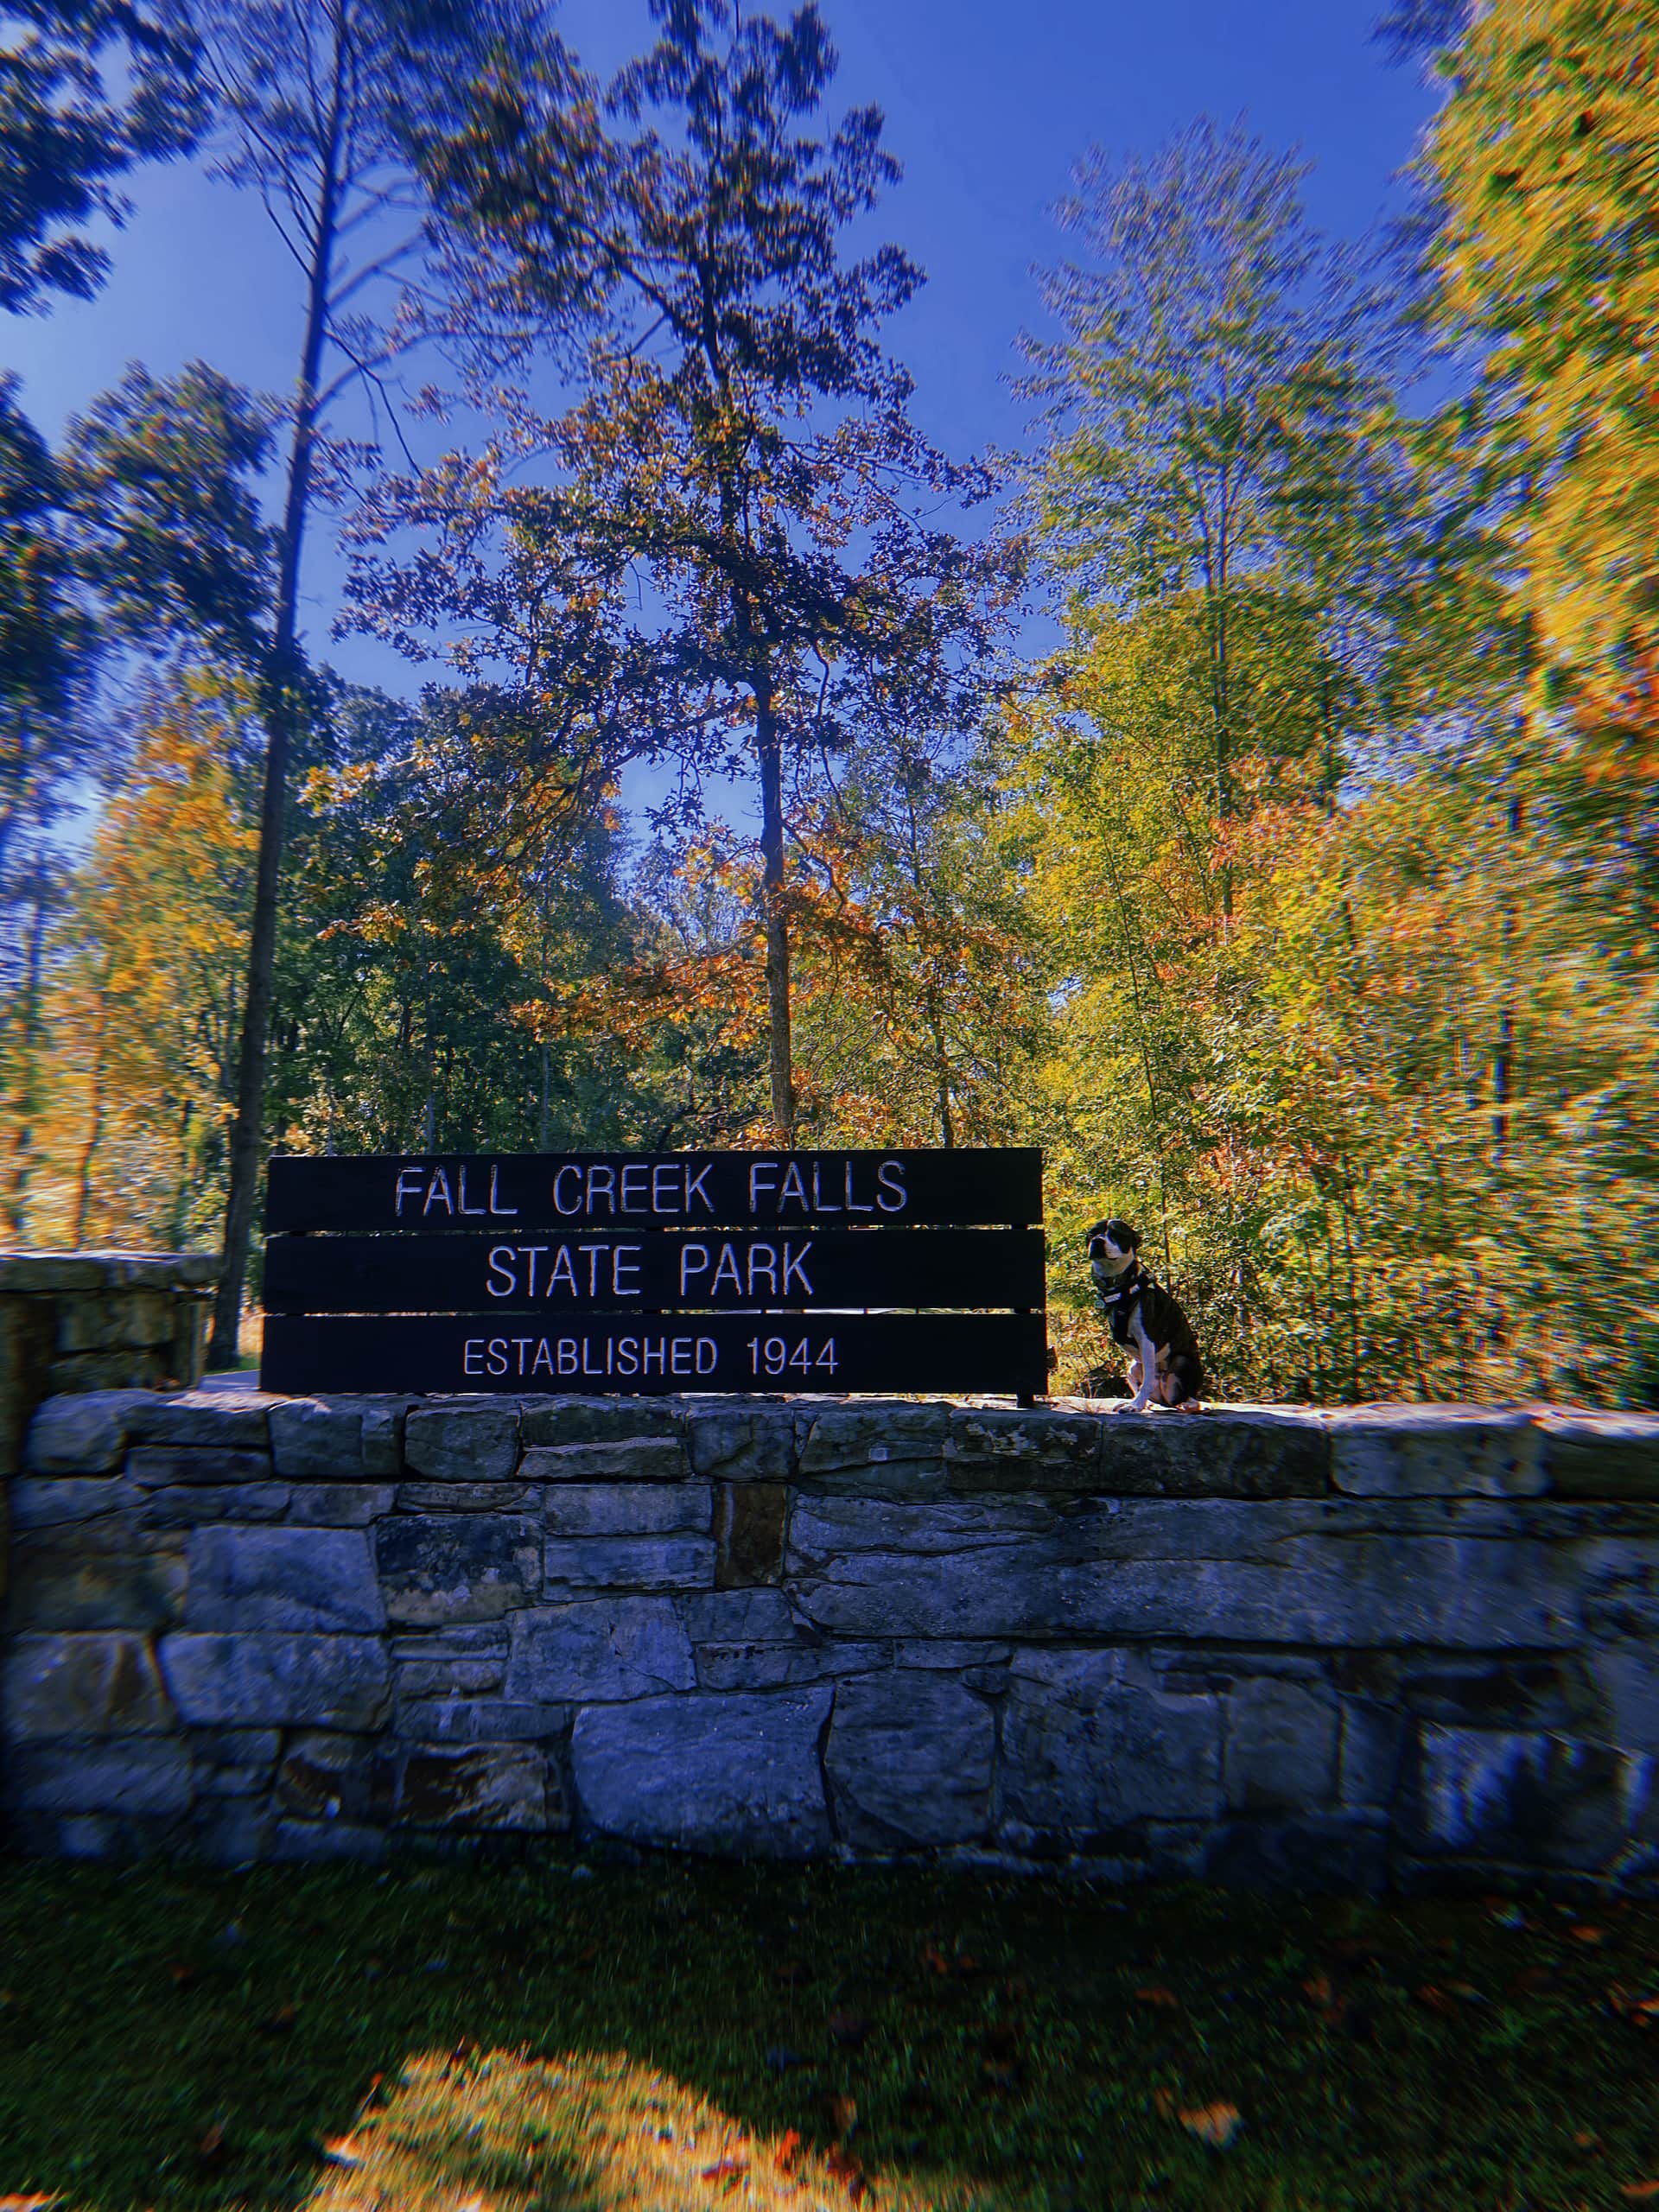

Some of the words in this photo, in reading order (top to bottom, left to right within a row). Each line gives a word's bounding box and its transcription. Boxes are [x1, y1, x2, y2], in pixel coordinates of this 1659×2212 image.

[394, 1165, 518, 1217] FALL
[553, 1163, 714, 1216] CREEK
[748, 1160, 907, 1212] FALLS
[486, 1244, 641, 1297] STATE
[680, 1242, 814, 1296] PARK
[463, 1337, 718, 1376] ESTABLISHED
[747, 1337, 839, 1376] 1944
